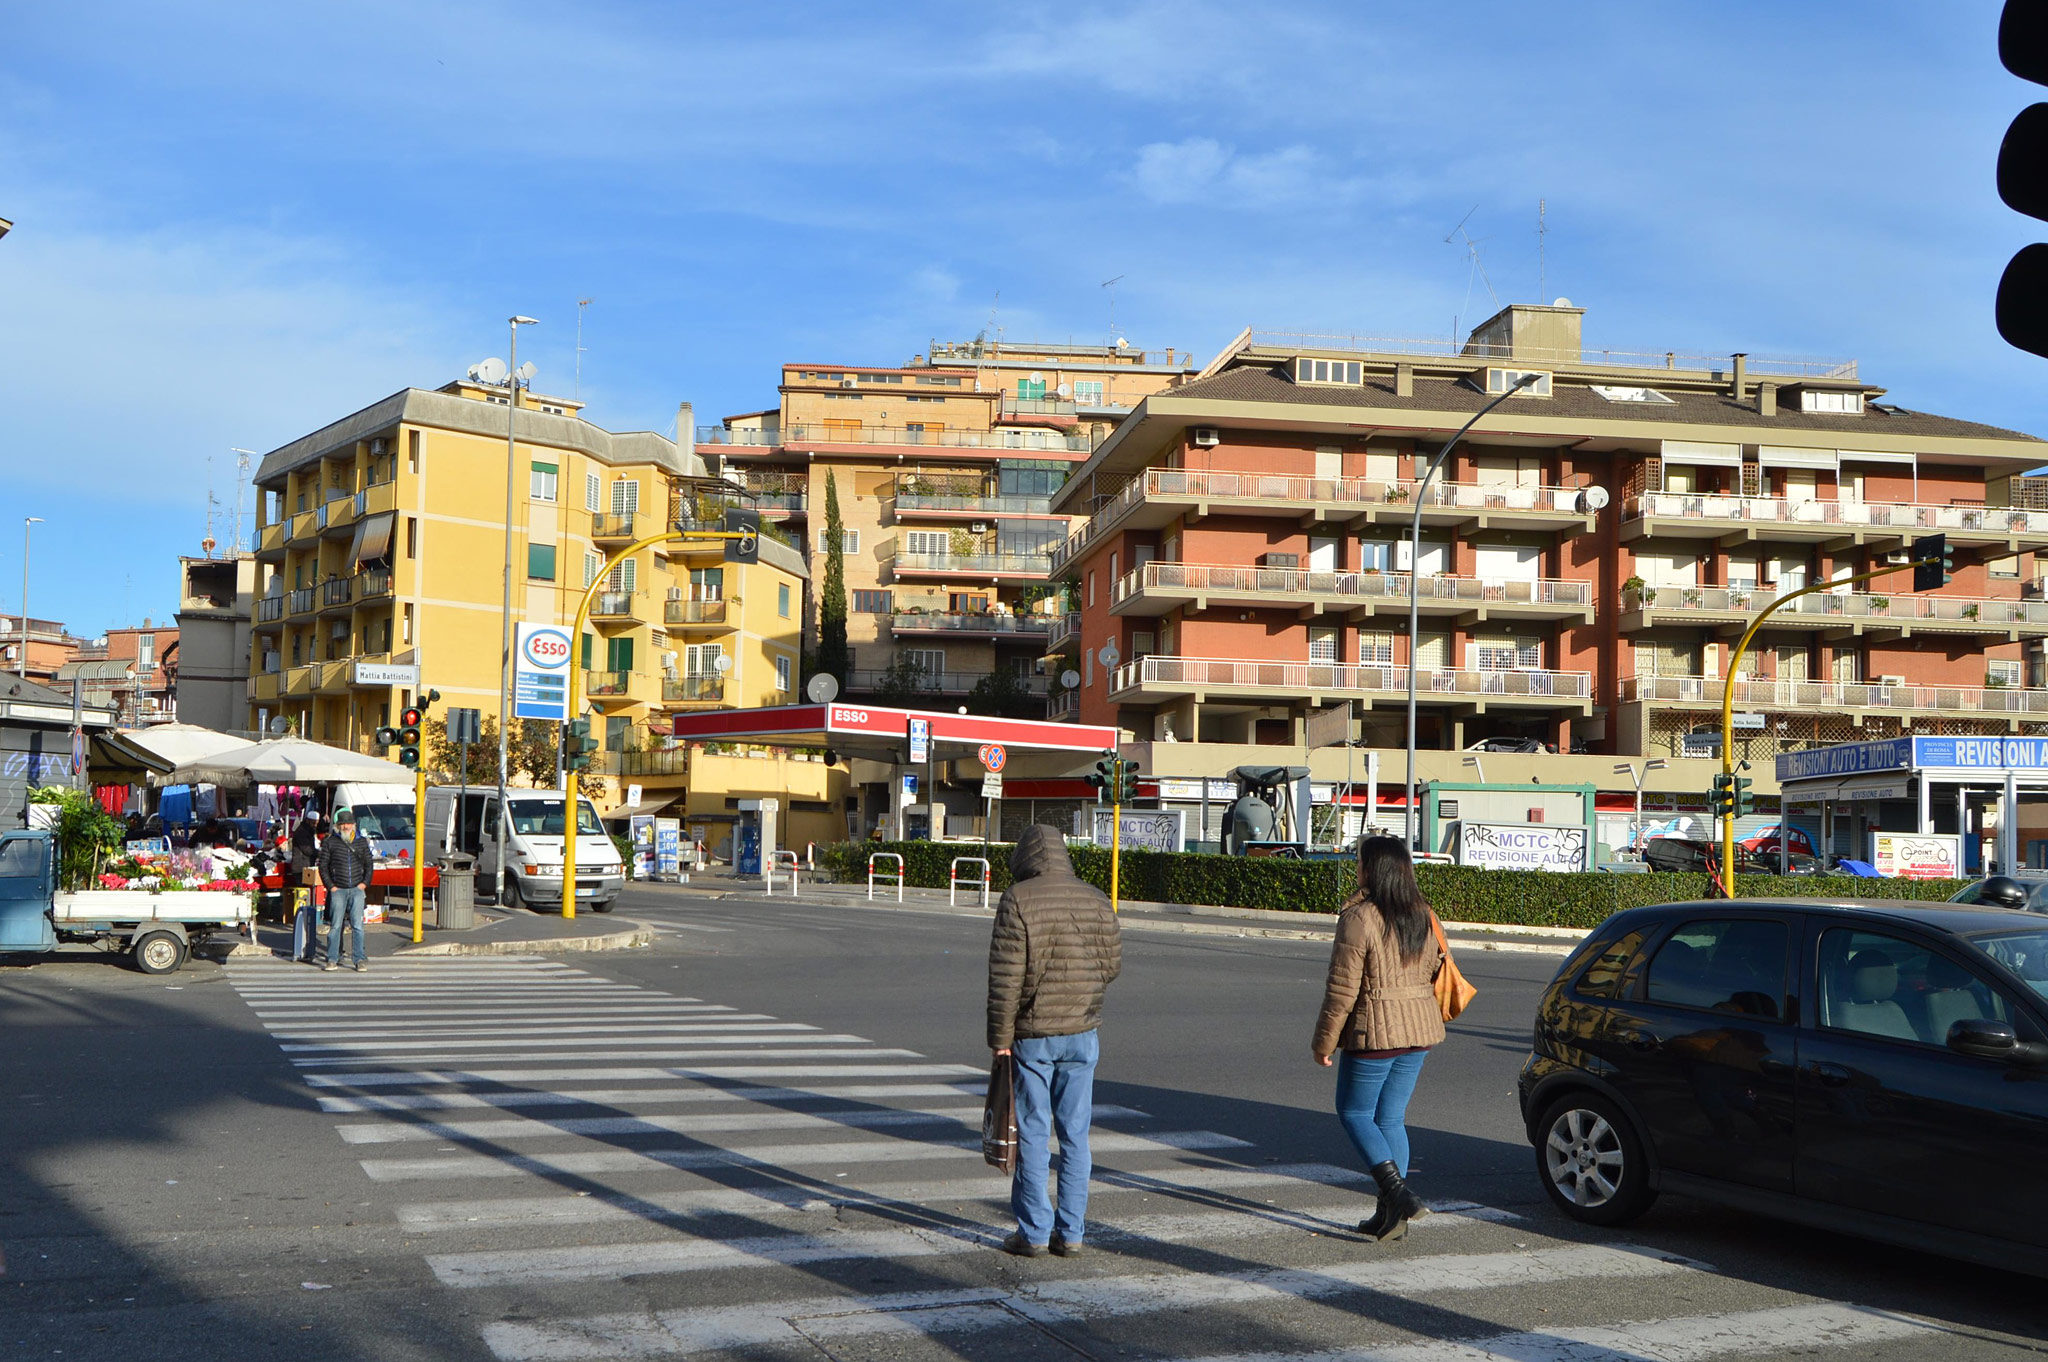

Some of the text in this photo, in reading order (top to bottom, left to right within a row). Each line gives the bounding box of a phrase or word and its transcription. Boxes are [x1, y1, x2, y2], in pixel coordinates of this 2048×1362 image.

[360, 672, 412, 681] Mattia Battistini
[835, 709, 868, 723] ESSO
[1788, 750, 1828, 777] REVISIONI
[1831, 748, 1856, 772] AUTO
[1860, 746, 1866, 768] E
[1868, 743, 1895, 768] MOTO
[1956, 741, 2036, 766] REVISIONI
[1792, 793, 1813, 801] REVISIONE
[1852, 789, 1893, 799] REVISIONE AUTO
[1119, 820, 1153, 834] MCTC
[1097, 835, 1173, 849] RESIONE AUTO
[1499, 833, 1550, 848] MCTC
[1468, 850, 1579, 864] REVISIONE AUTO
